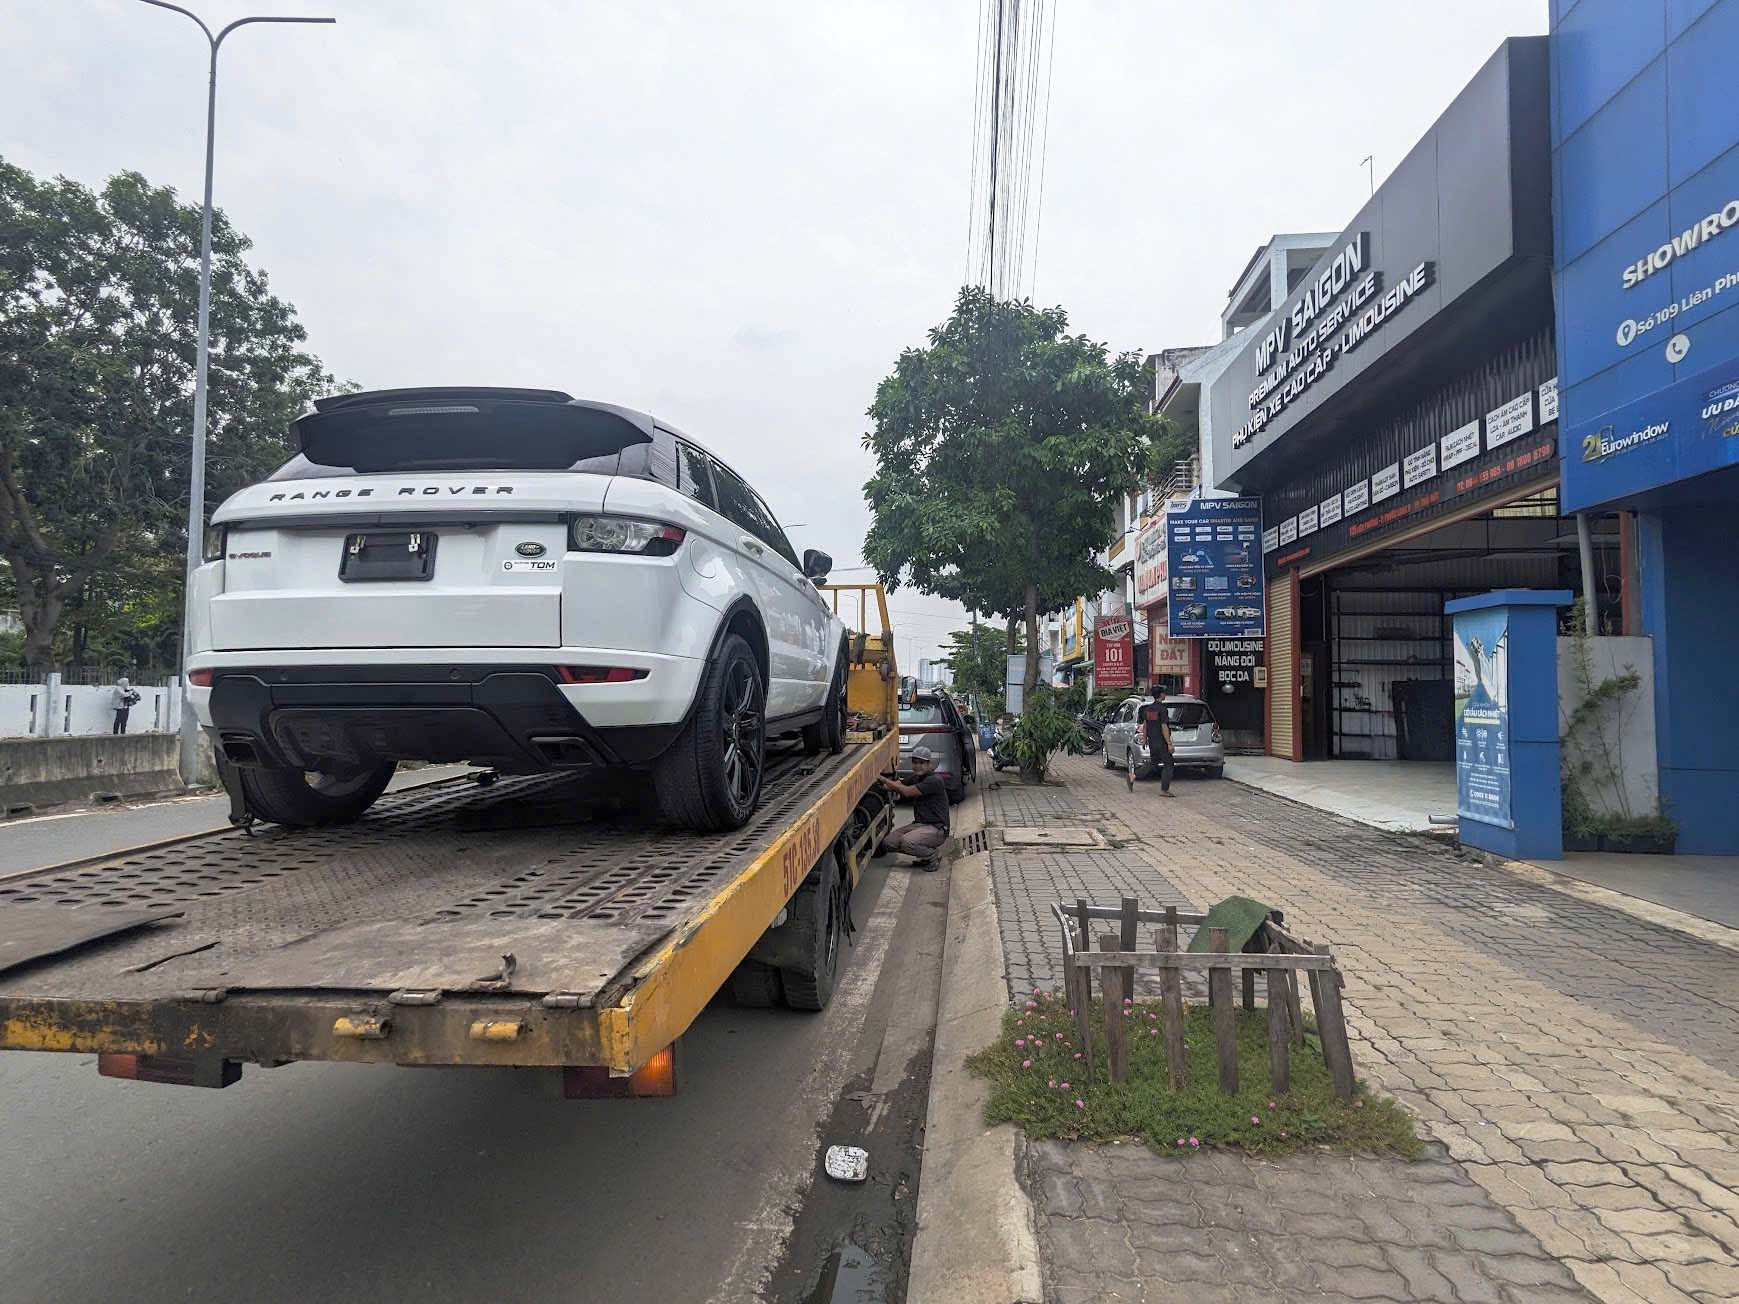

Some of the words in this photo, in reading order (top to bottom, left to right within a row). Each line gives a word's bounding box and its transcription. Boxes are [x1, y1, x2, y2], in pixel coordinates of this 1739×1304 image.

[1255, 318, 1287, 376] MPV
[1292, 232, 1362, 339] SAIGON
[1637, 313, 1655, 334] Số
[1655, 303, 1679, 325] 109
[1681, 287, 1712, 312] Liên
[1714, 271, 1739, 294] Ph
[1248, 361, 1287, 410] PREMIUM
[1288, 330, 1317, 373] AUTO
[1319, 272, 1375, 343] SERVICE
[1269, 393, 1282, 418] XE
[1283, 372, 1305, 404] CAO
[1306, 347, 1332, 384] CẤP
[1341, 262, 1426, 354] LIMOUSINE
[1601, 422, 1669, 456] Eurowindow
[269, 488, 374, 502] RANGE
[398, 486, 514, 495] ROVER
[1200, 502, 1221, 510] MPV
[1222, 501, 1258, 510] SAIGON
[1220, 640, 1264, 652] LIMOUSINE
[1105, 648, 1123, 662] 101
[1214, 653, 1240, 666] NÂNG
[1237, 670, 1250, 681] DA
